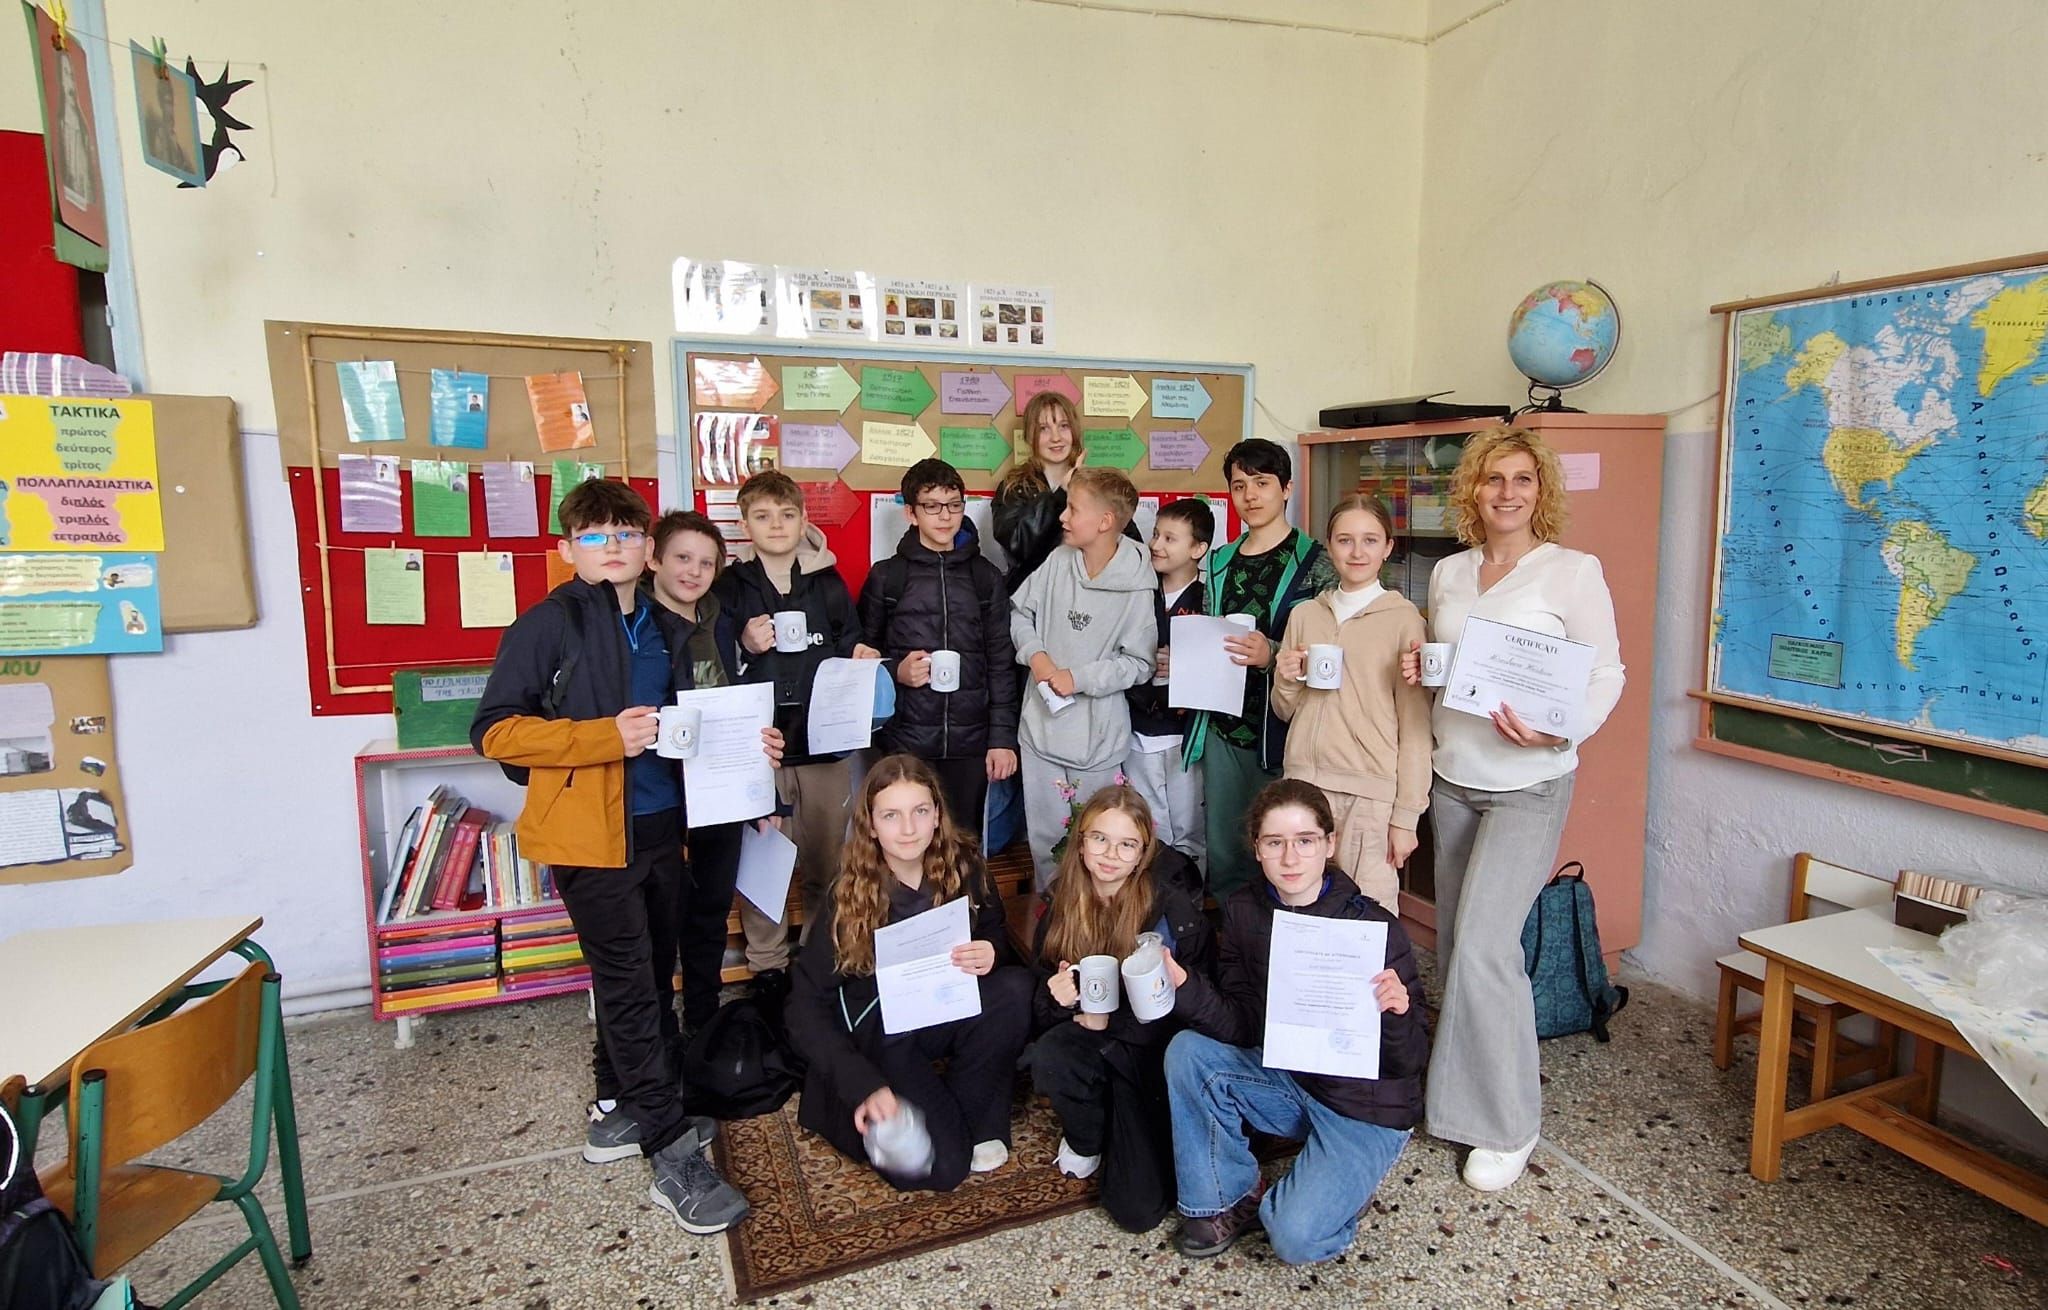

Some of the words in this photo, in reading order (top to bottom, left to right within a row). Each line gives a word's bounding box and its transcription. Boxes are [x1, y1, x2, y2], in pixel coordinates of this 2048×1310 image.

[49, 405, 121, 419] ΤΑΚΤΙΚΑ
[61, 427, 107, 438] πρώτος
[56, 443, 112, 455] δεύτερος
[64, 460, 102, 471] τρίτος
[17, 477, 154, 491] ΠΟΛΛΑΠΛΑΣΙΑΣΤΙΚΑ
[61, 496, 105, 507] διπλός
[59, 514, 110, 526] τριπλός
[53, 532, 122, 543] τετραπλός
